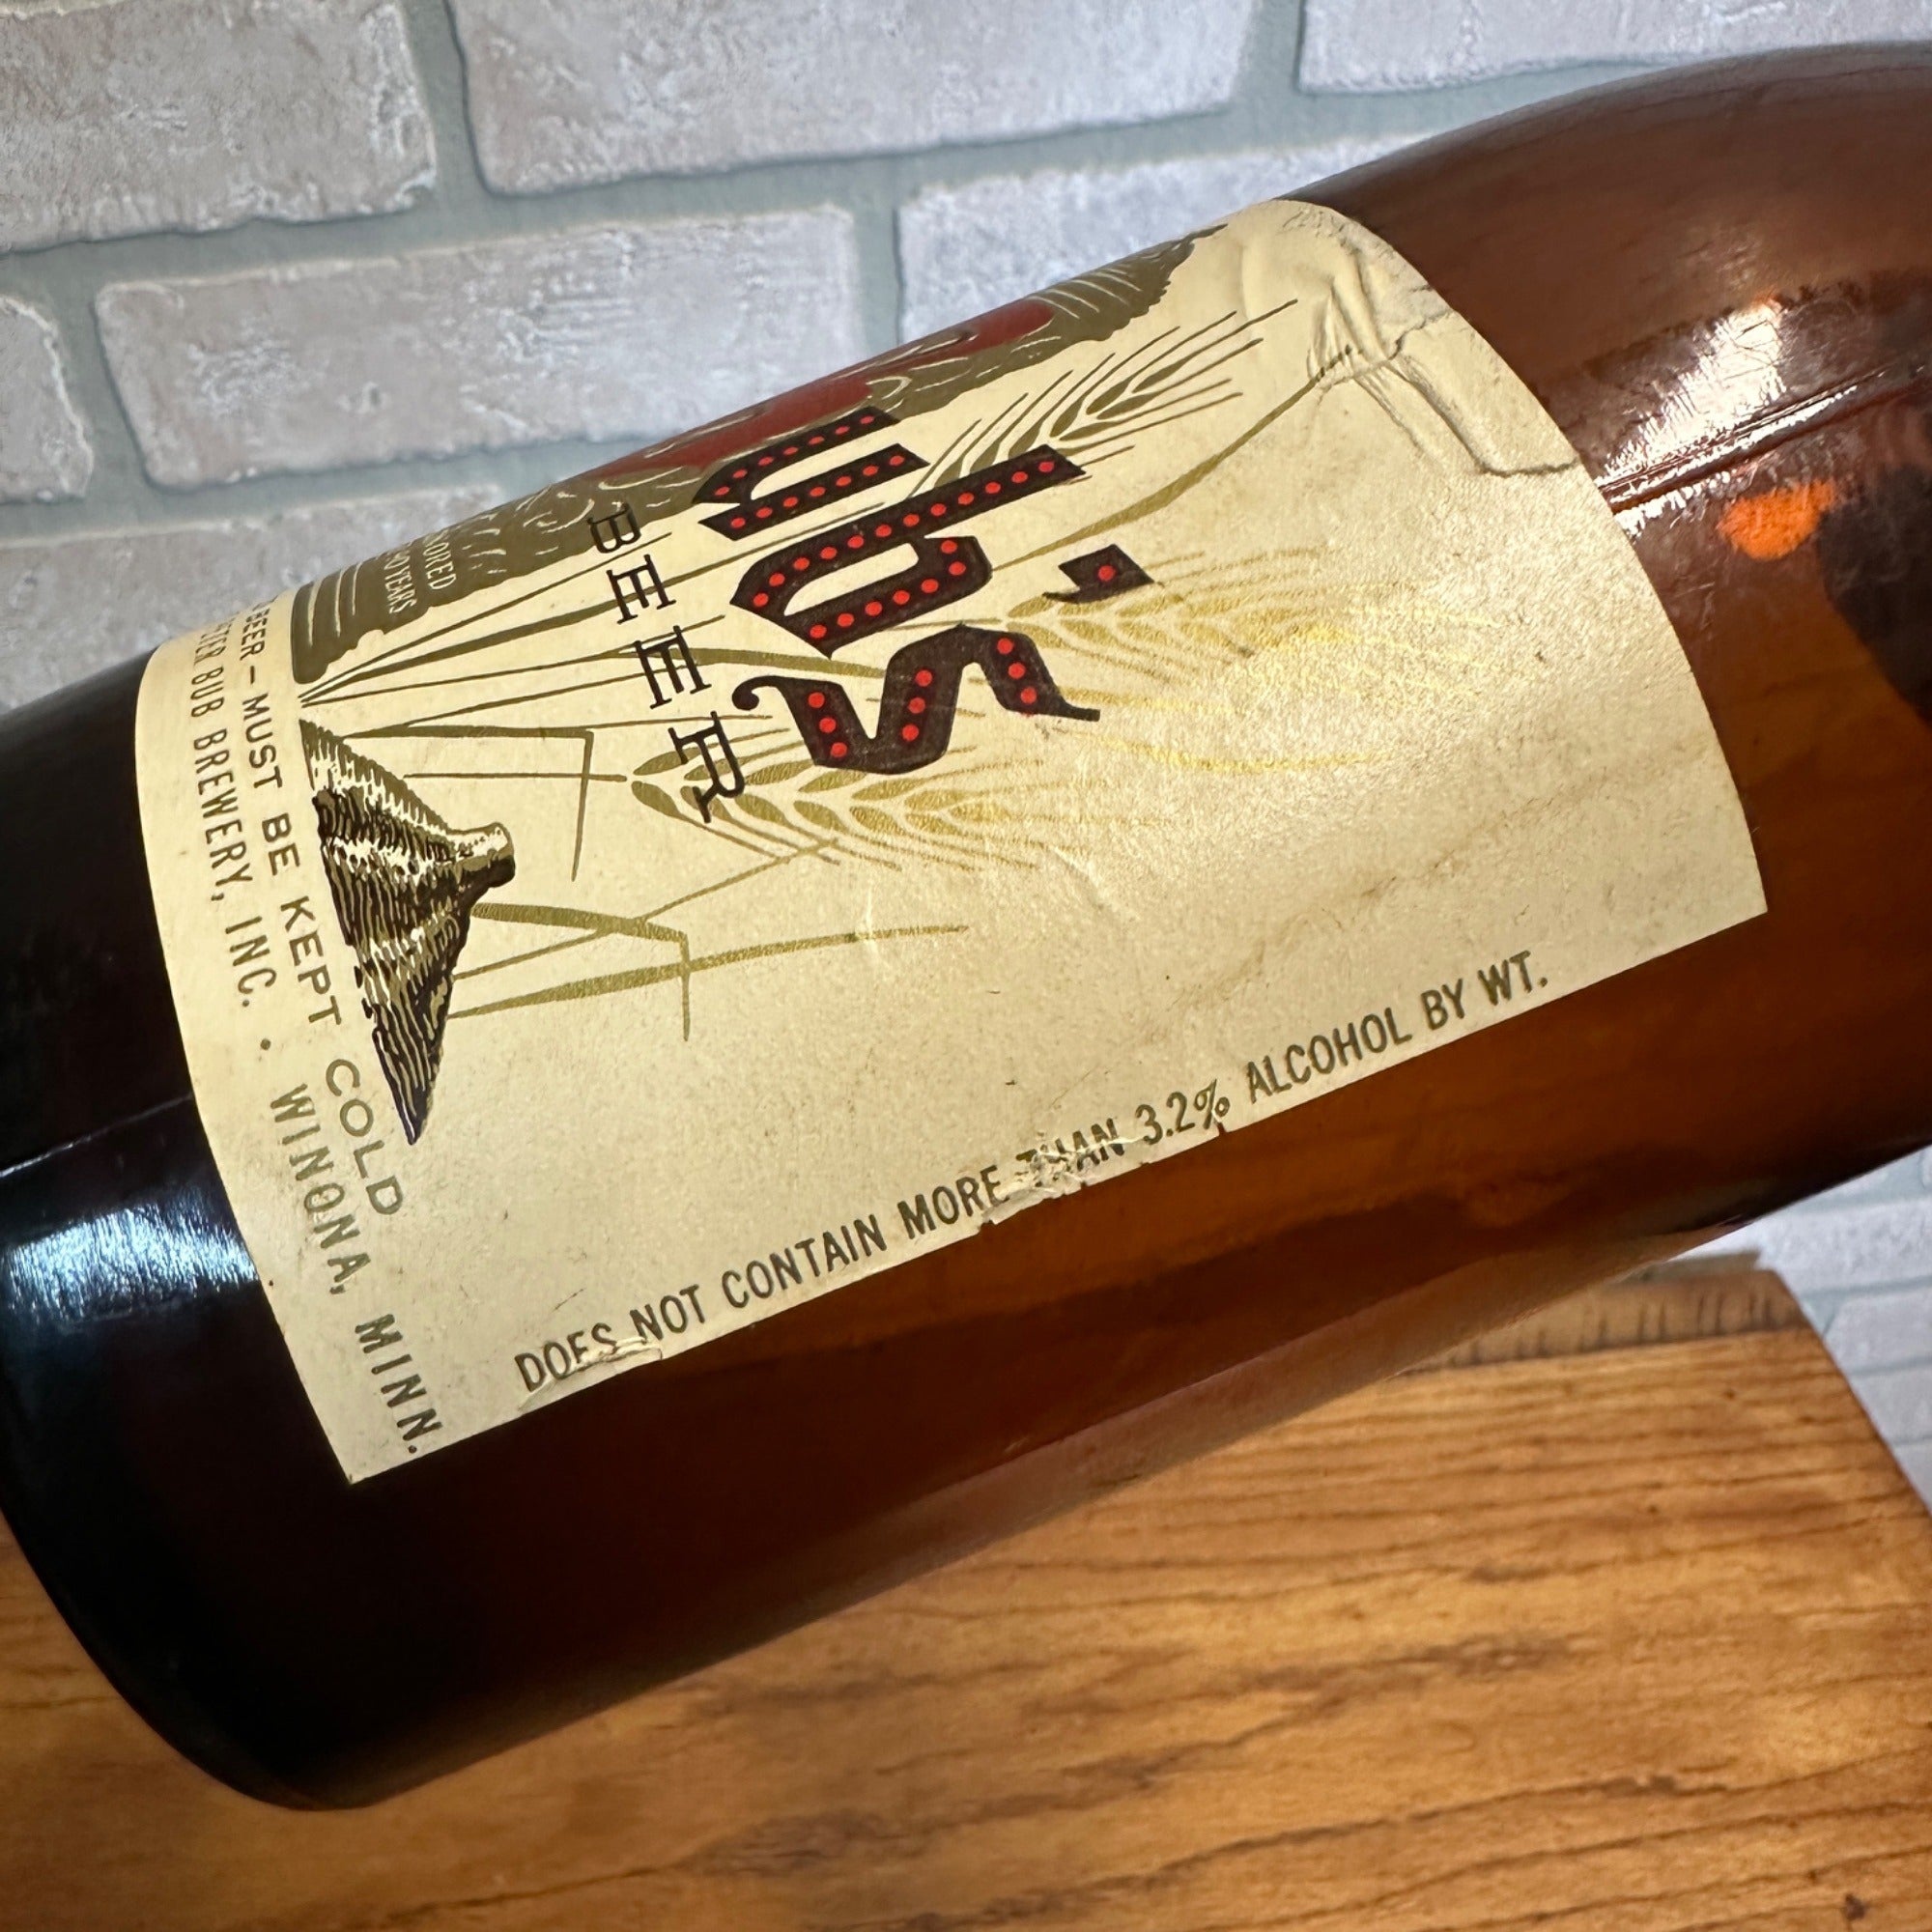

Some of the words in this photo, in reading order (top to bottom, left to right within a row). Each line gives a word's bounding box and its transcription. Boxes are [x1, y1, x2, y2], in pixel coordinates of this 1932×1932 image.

[384, 565, 417, 614] YEARS
[692, 405, 1154, 775] ub's
[189, 666, 226, 719] BUB
[588, 502, 746, 824] BEER
[242, 693, 283, 789] MUST
[192, 728, 254, 902] BREWERY,
[261, 812, 300, 876] BE
[224, 916, 277, 1009] INC.
[280, 895, 341, 1025] KEPT
[270, 1083, 371, 1295] WINONA,
[325, 1058, 404, 1217] COLD
[514, 1322, 619, 1393] DOES
[630, 1284, 705, 1342] NOT
[722, 1214, 887, 1309] CONTAIN
[897, 1164, 1009, 1241] MORE
[1135, 1078, 1231, 1146] 3.2%
[1245, 1008, 1413, 1104] ALCOHOL
[1421, 980, 1468, 1031] BY
[1478, 950, 1549, 1006] WT.
[355, 1313, 443, 1454] MINN.
